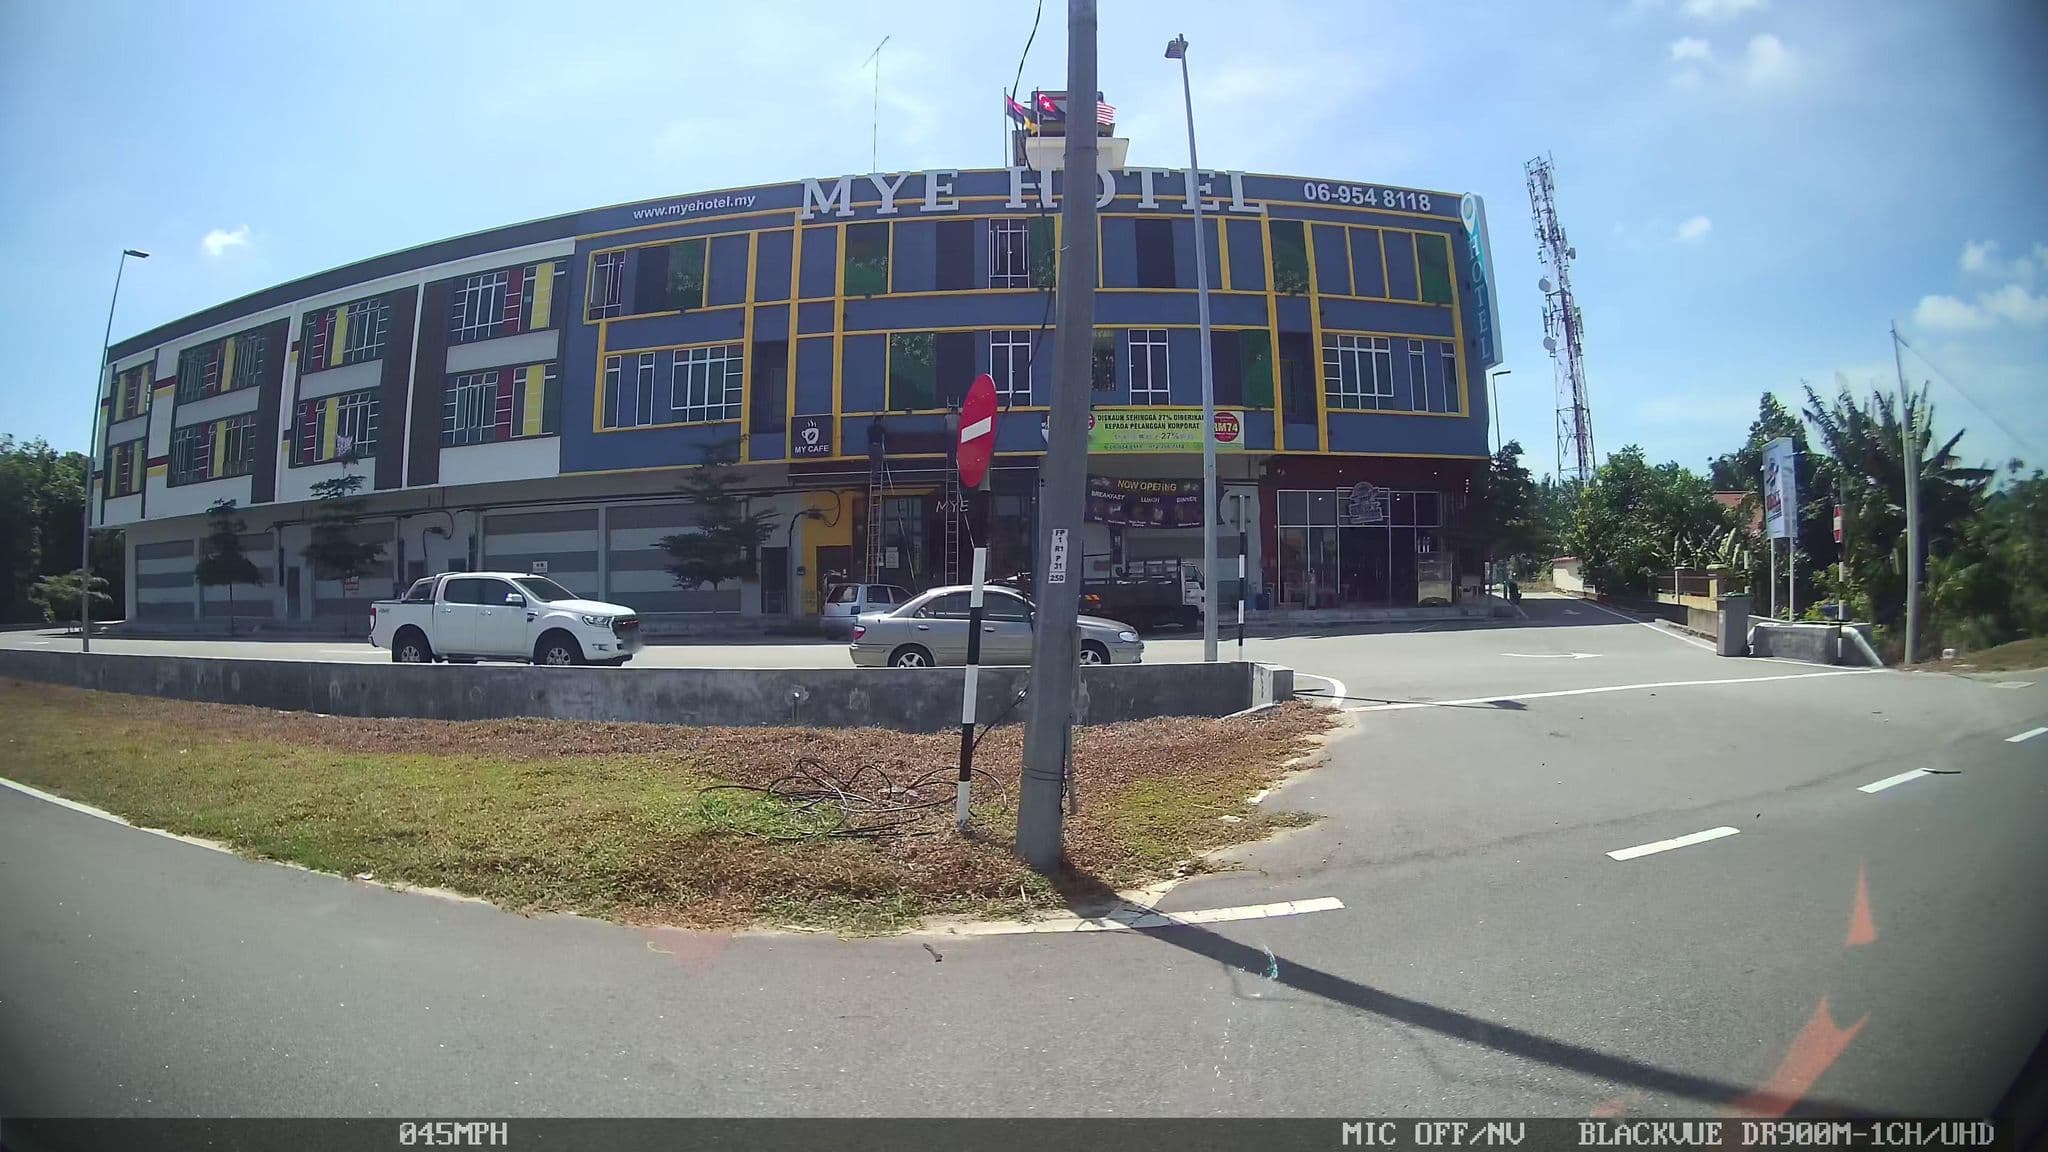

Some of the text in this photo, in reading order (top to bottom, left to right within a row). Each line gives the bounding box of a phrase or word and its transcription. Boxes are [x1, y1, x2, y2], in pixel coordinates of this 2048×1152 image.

[801, 168, 960, 220] MYE
[1303, 181, 1432, 212] 06-954 8118
[633, 194, 756, 220] www.myehotel.my
[1469, 234, 1491, 359] HOTEL
[1126, 414, 1157, 422] SEHINGGA
[794, 445, 829, 454] MY CAFE
[1117, 480, 1139, 490] NOW
[1091, 490, 1125, 500] BREAKFAST
[936, 500, 969, 513] MYE
